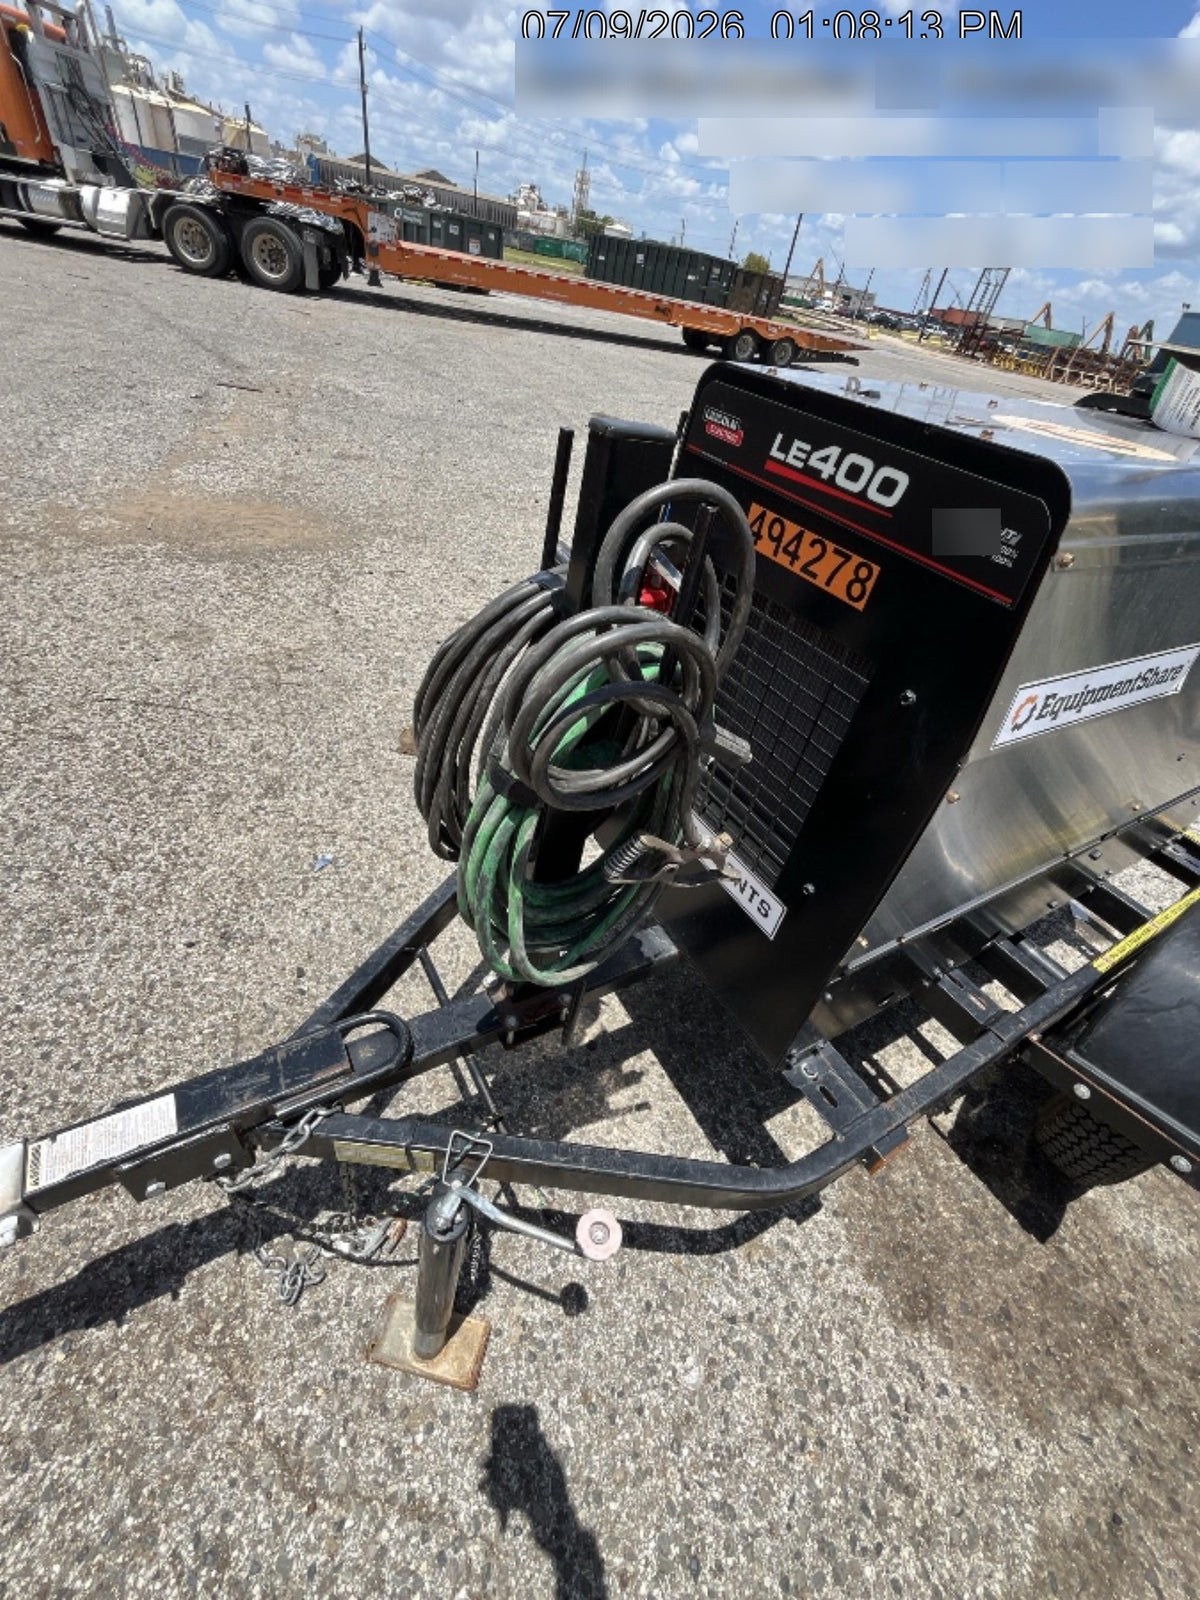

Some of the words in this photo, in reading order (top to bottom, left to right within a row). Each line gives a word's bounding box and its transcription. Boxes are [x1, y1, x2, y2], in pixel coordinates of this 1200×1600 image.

[769, 432, 910, 507] LE400
[750, 510, 874, 602] 494278
[1035, 664, 1185, 721] EquipmentShare
[731, 878, 771, 918] NTS
